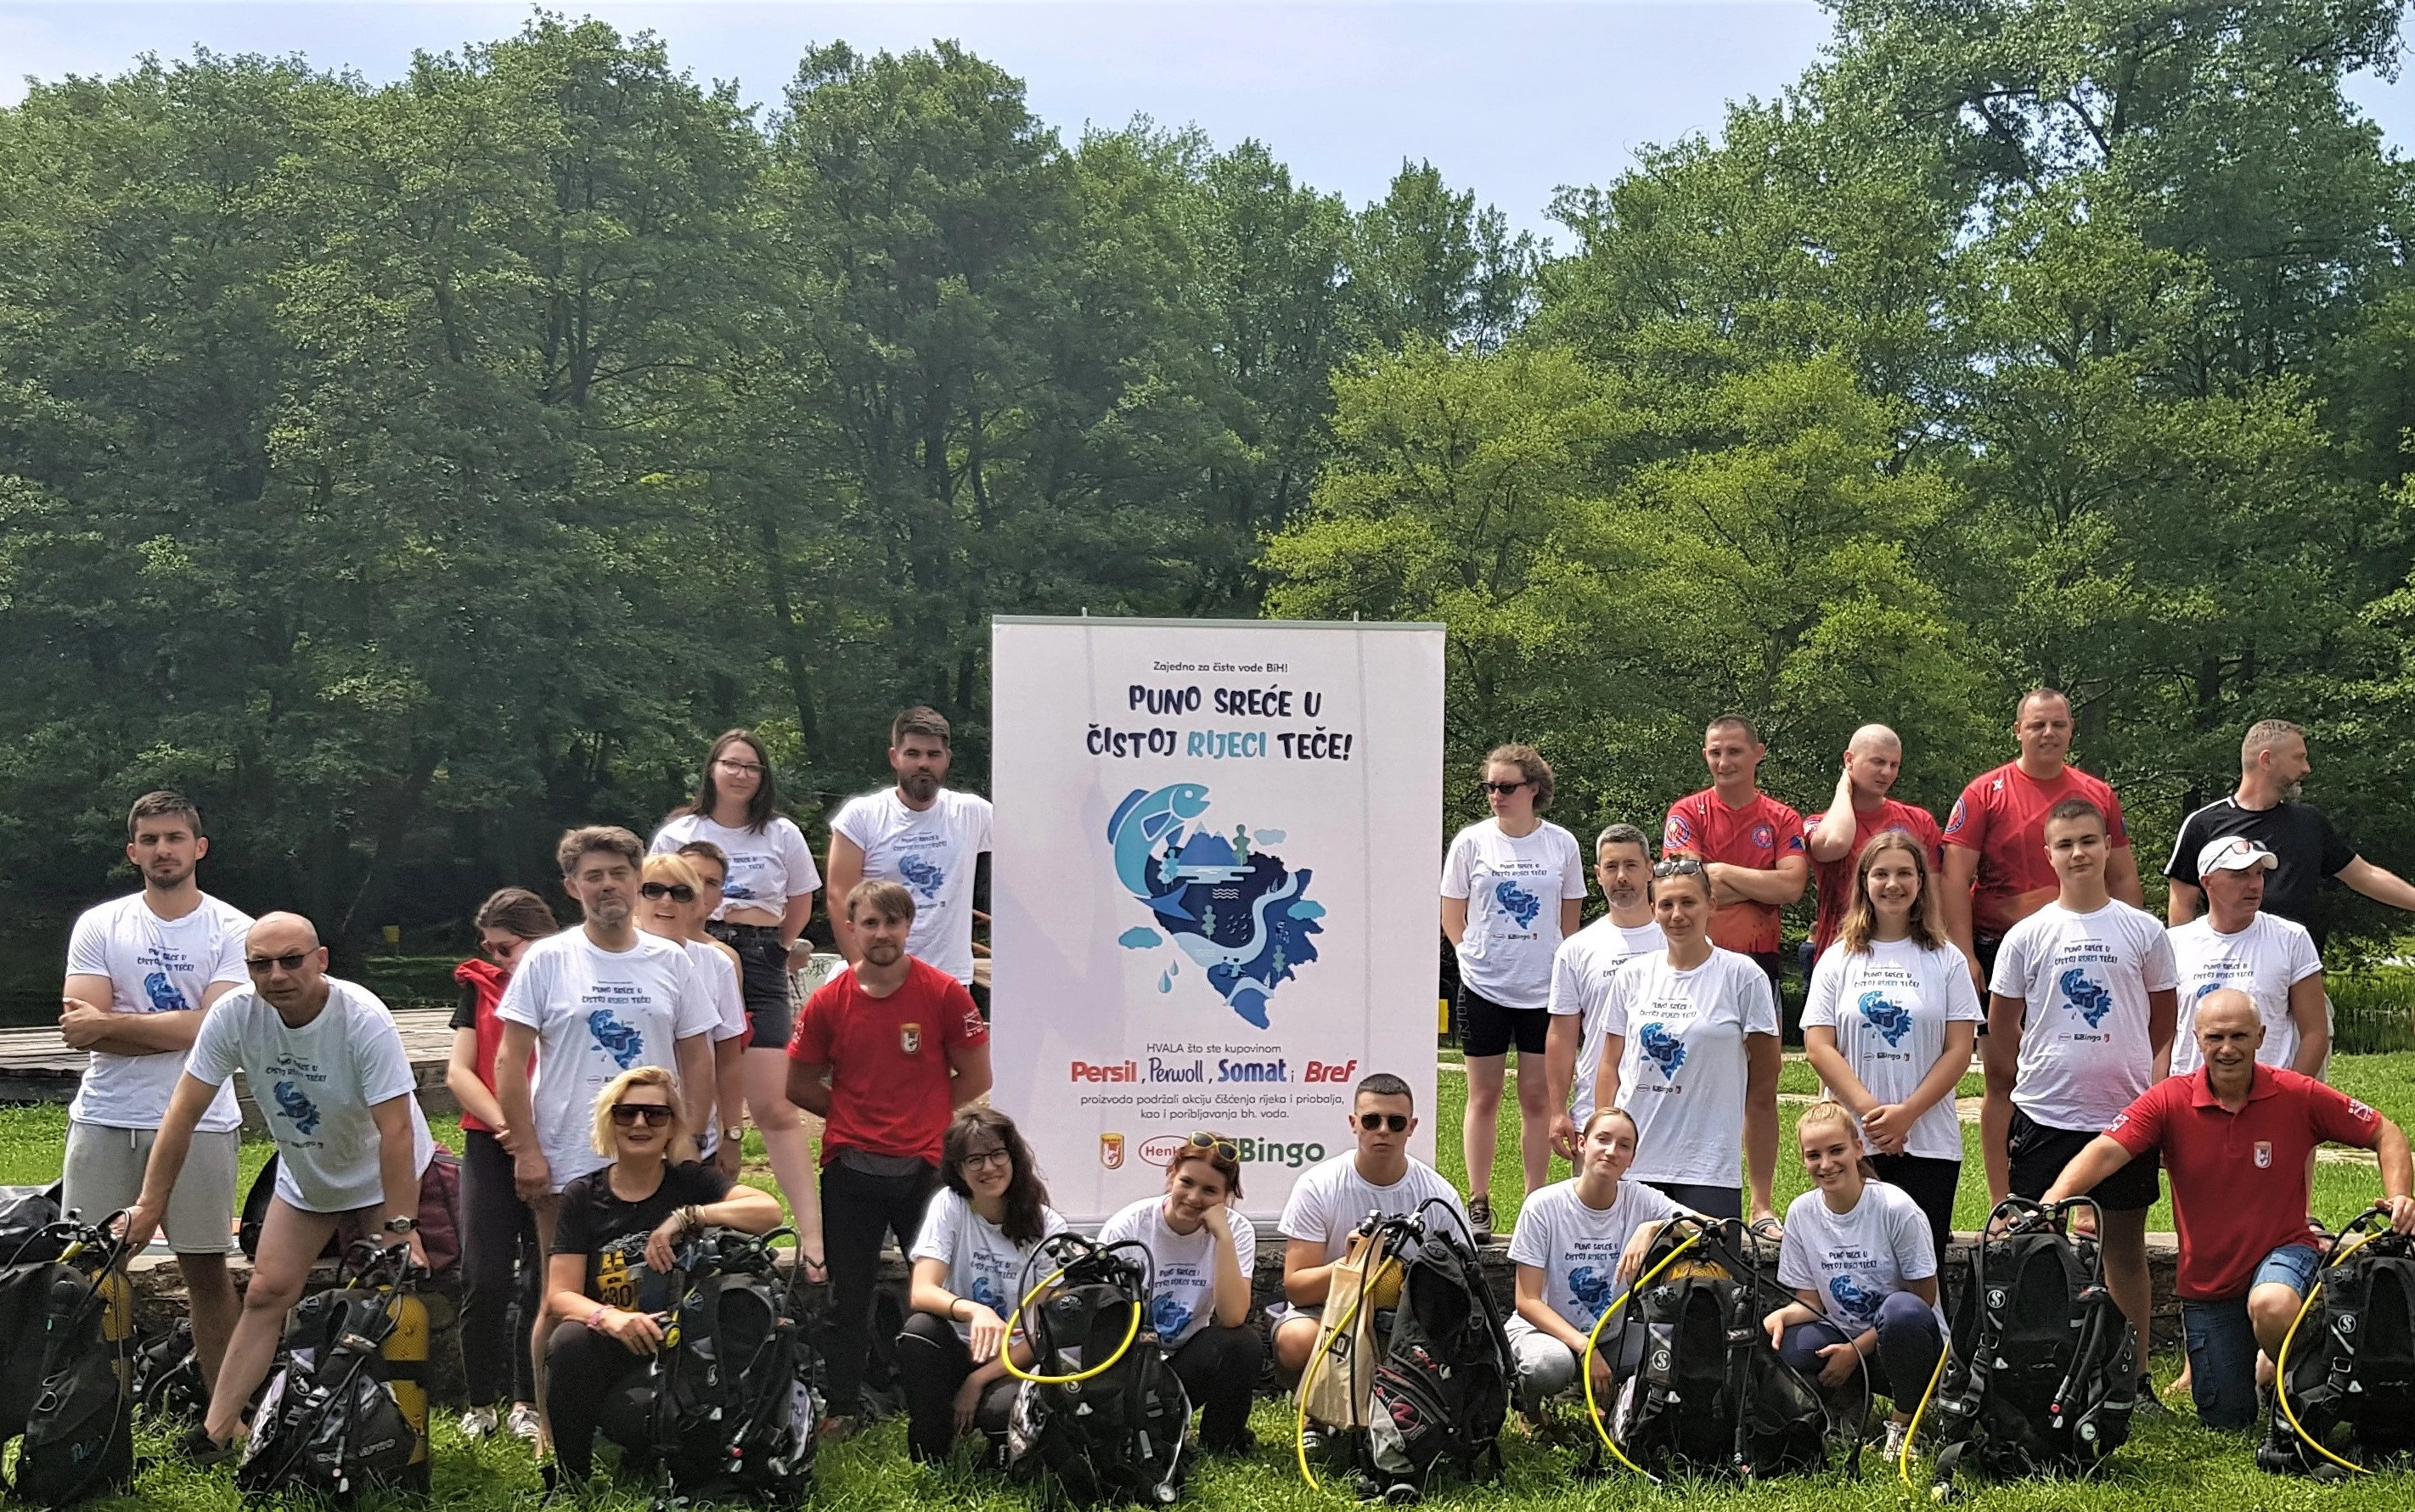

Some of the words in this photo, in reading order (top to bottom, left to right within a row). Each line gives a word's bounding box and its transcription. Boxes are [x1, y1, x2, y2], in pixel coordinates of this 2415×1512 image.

[1153, 661, 1196, 673] Zajedno
[1213, 662, 1236, 672] čiste
[1237, 663, 1264, 672] vode
[1266, 663, 1288, 672] BiH!
[1129, 684, 1202, 716] PUNO
[1214, 683, 1293, 717] SREĆE
[1304, 691, 1323, 717] U
[1086, 722, 1178, 759] ČISTOJ
[1187, 729, 1267, 760] RIJECI
[1276, 726, 1353, 762] TEČE!
[1146, 1043, 1185, 1053] HVALA
[1187, 1043, 1203, 1054] što
[1206, 1044, 1222, 1054] ste
[1224, 1043, 1281, 1055] kupovinom
[1218, 1059, 1287, 1082] Somat
[1291, 1070, 1294, 1083] i
[1304, 1060, 1358, 1082] Bref
[1080, 1093, 1134, 1106] proizvoda
[1136, 1093, 1179, 1106] podržali
[1182, 1093, 1212, 1106] akciju
[1214, 1093, 1256, 1106] čišćenja
[1259, 1093, 1286, 1106] rijeka
[1296, 1093, 1345, 1106] priobalja,
[1140, 1109, 1160, 1119] kao
[1169, 1109, 1237, 1121] poribljavanja
[1241, 1109, 1258, 1119] bh.
[1260, 1109, 1290, 1119] voda.
[1239, 1138, 1326, 1168] Bingo
